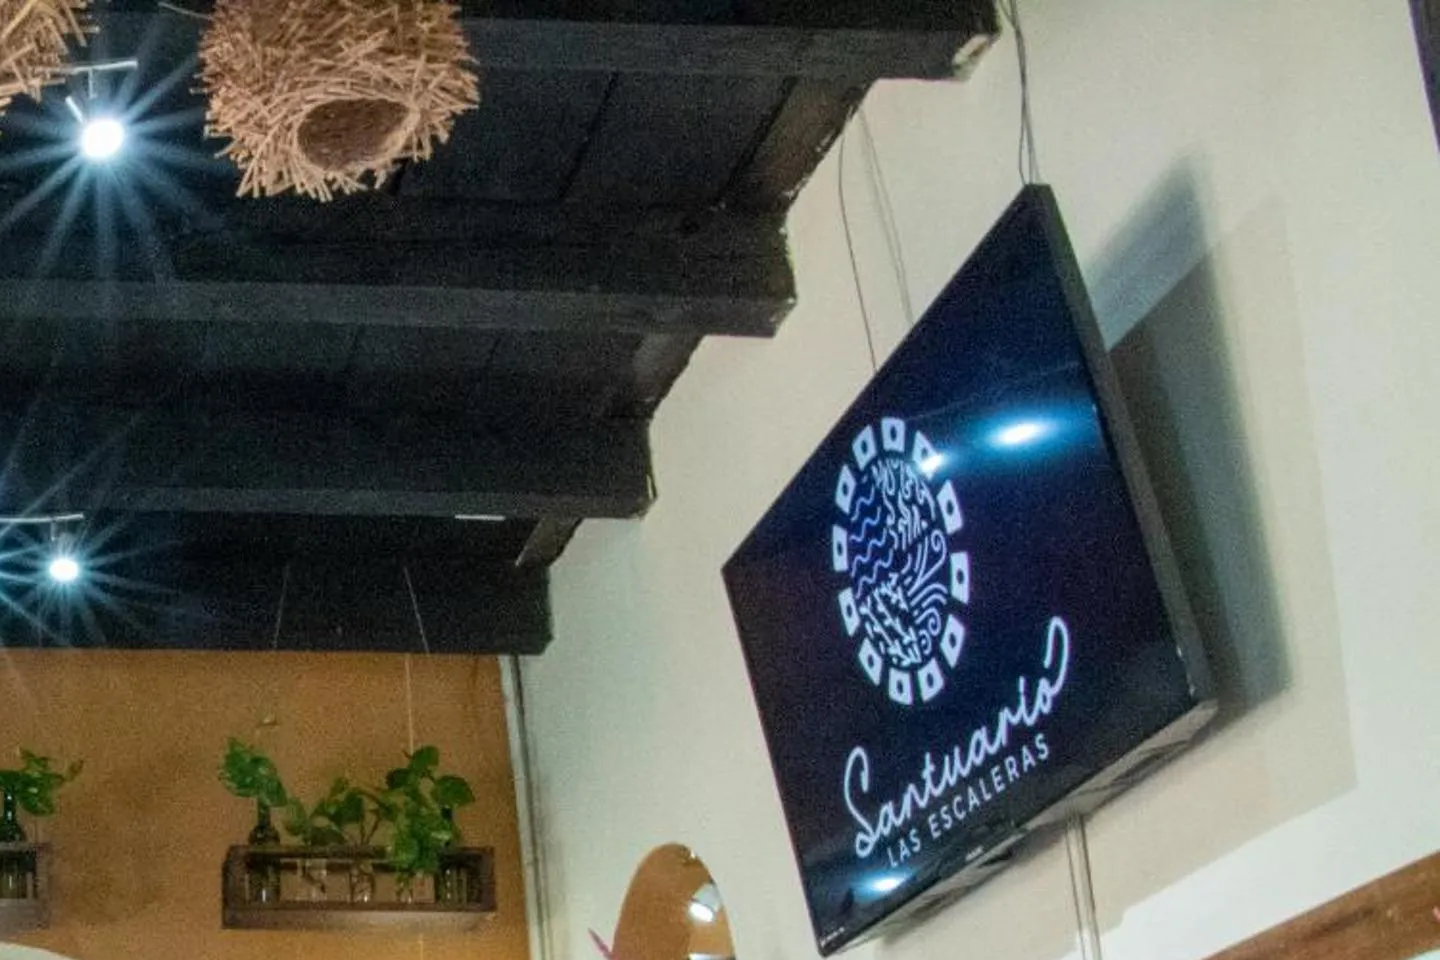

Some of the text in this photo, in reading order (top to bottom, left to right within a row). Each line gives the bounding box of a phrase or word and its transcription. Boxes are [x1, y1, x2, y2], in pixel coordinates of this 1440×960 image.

[843, 615, 1070, 859] Santuario
[886, 732, 1050, 869] LAS ESCALERAS
